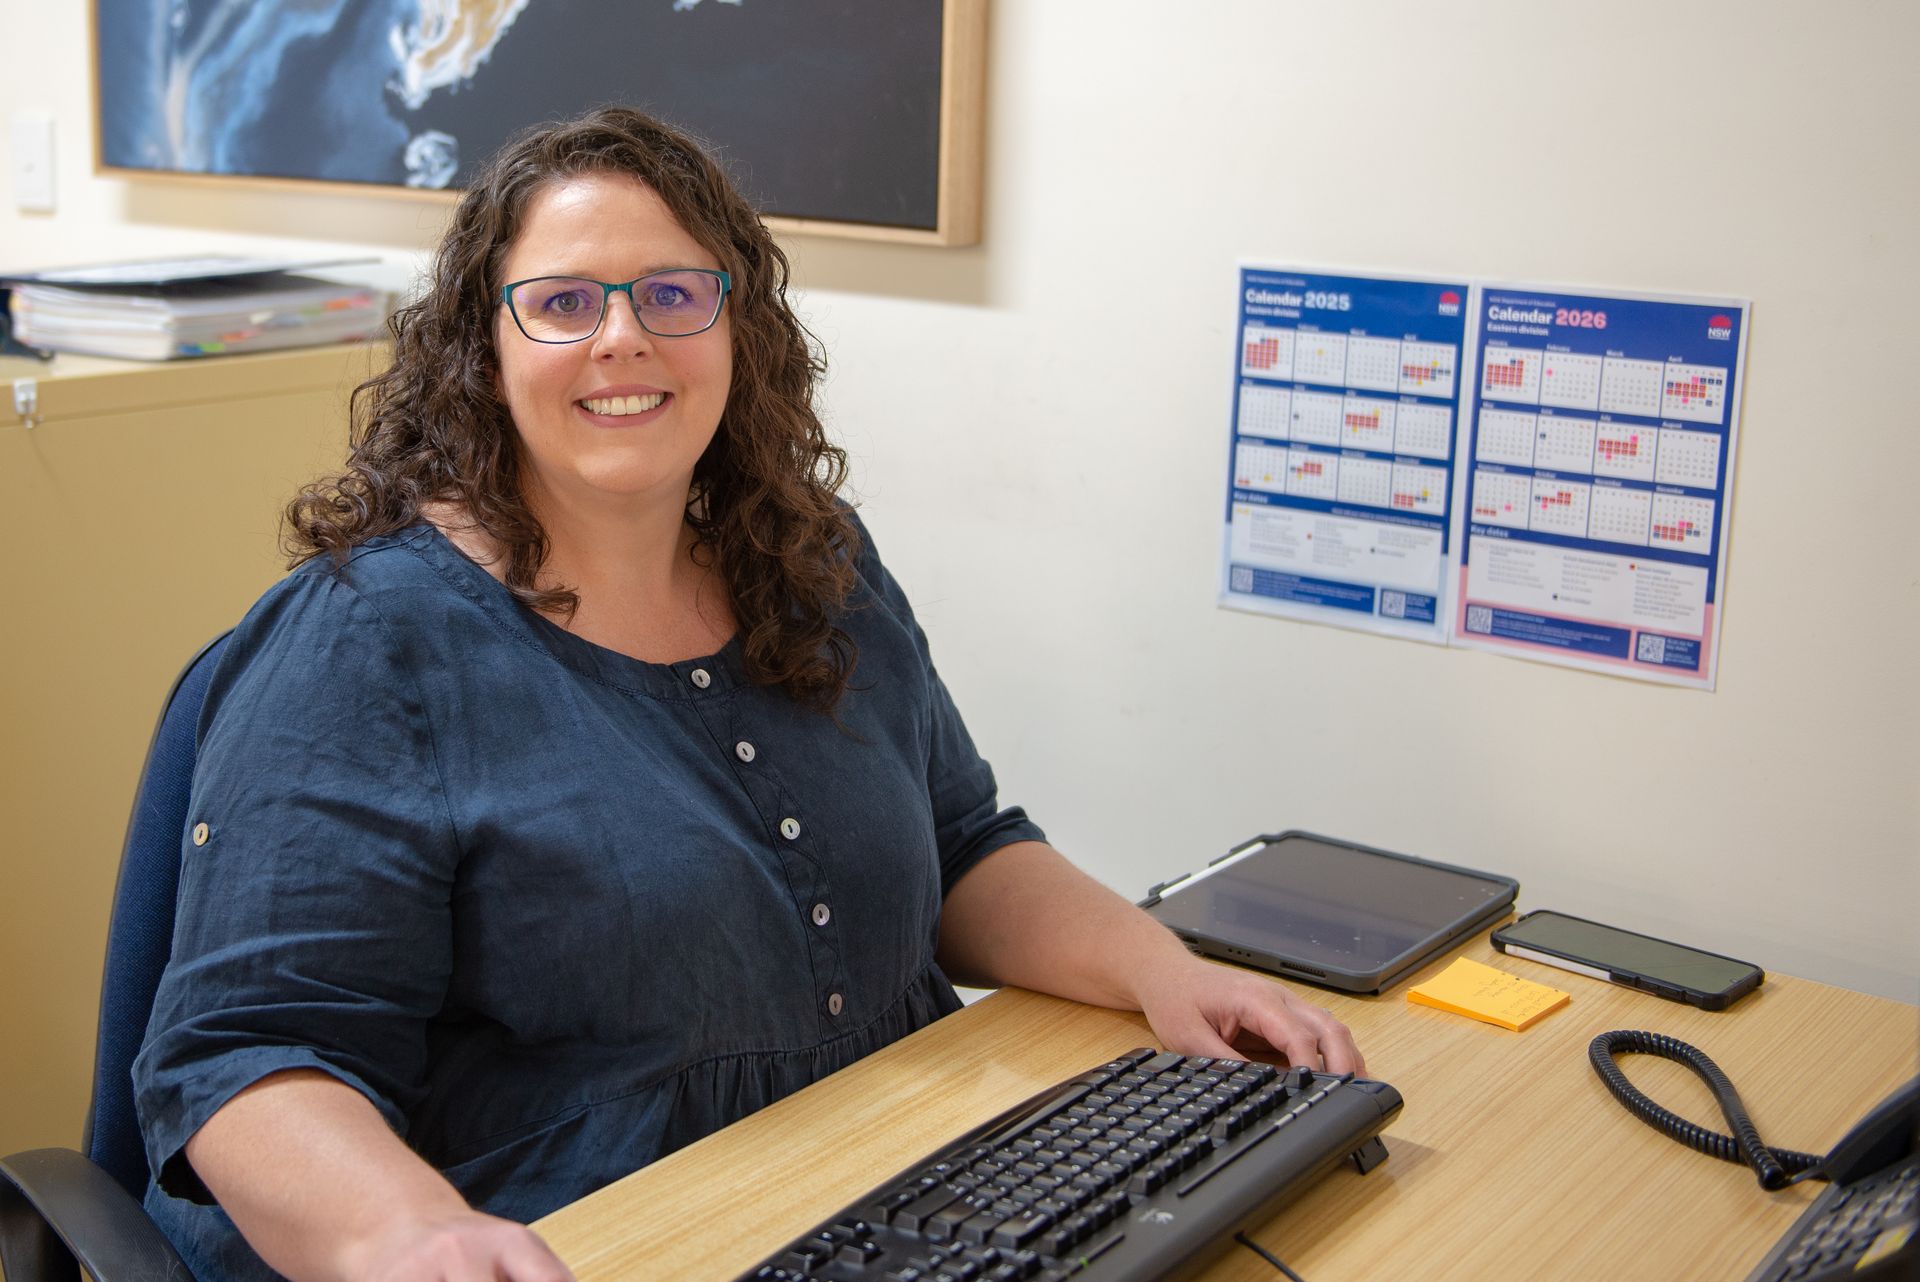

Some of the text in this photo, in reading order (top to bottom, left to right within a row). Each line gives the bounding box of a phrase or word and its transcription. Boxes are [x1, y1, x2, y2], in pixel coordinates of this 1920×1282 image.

[1245, 288, 1351, 311] Calendar 2025
[1488, 305, 1607, 329] Calendar 2026
[1487, 322, 1549, 337] Eastern division
[1708, 327, 1731, 338] NSW
